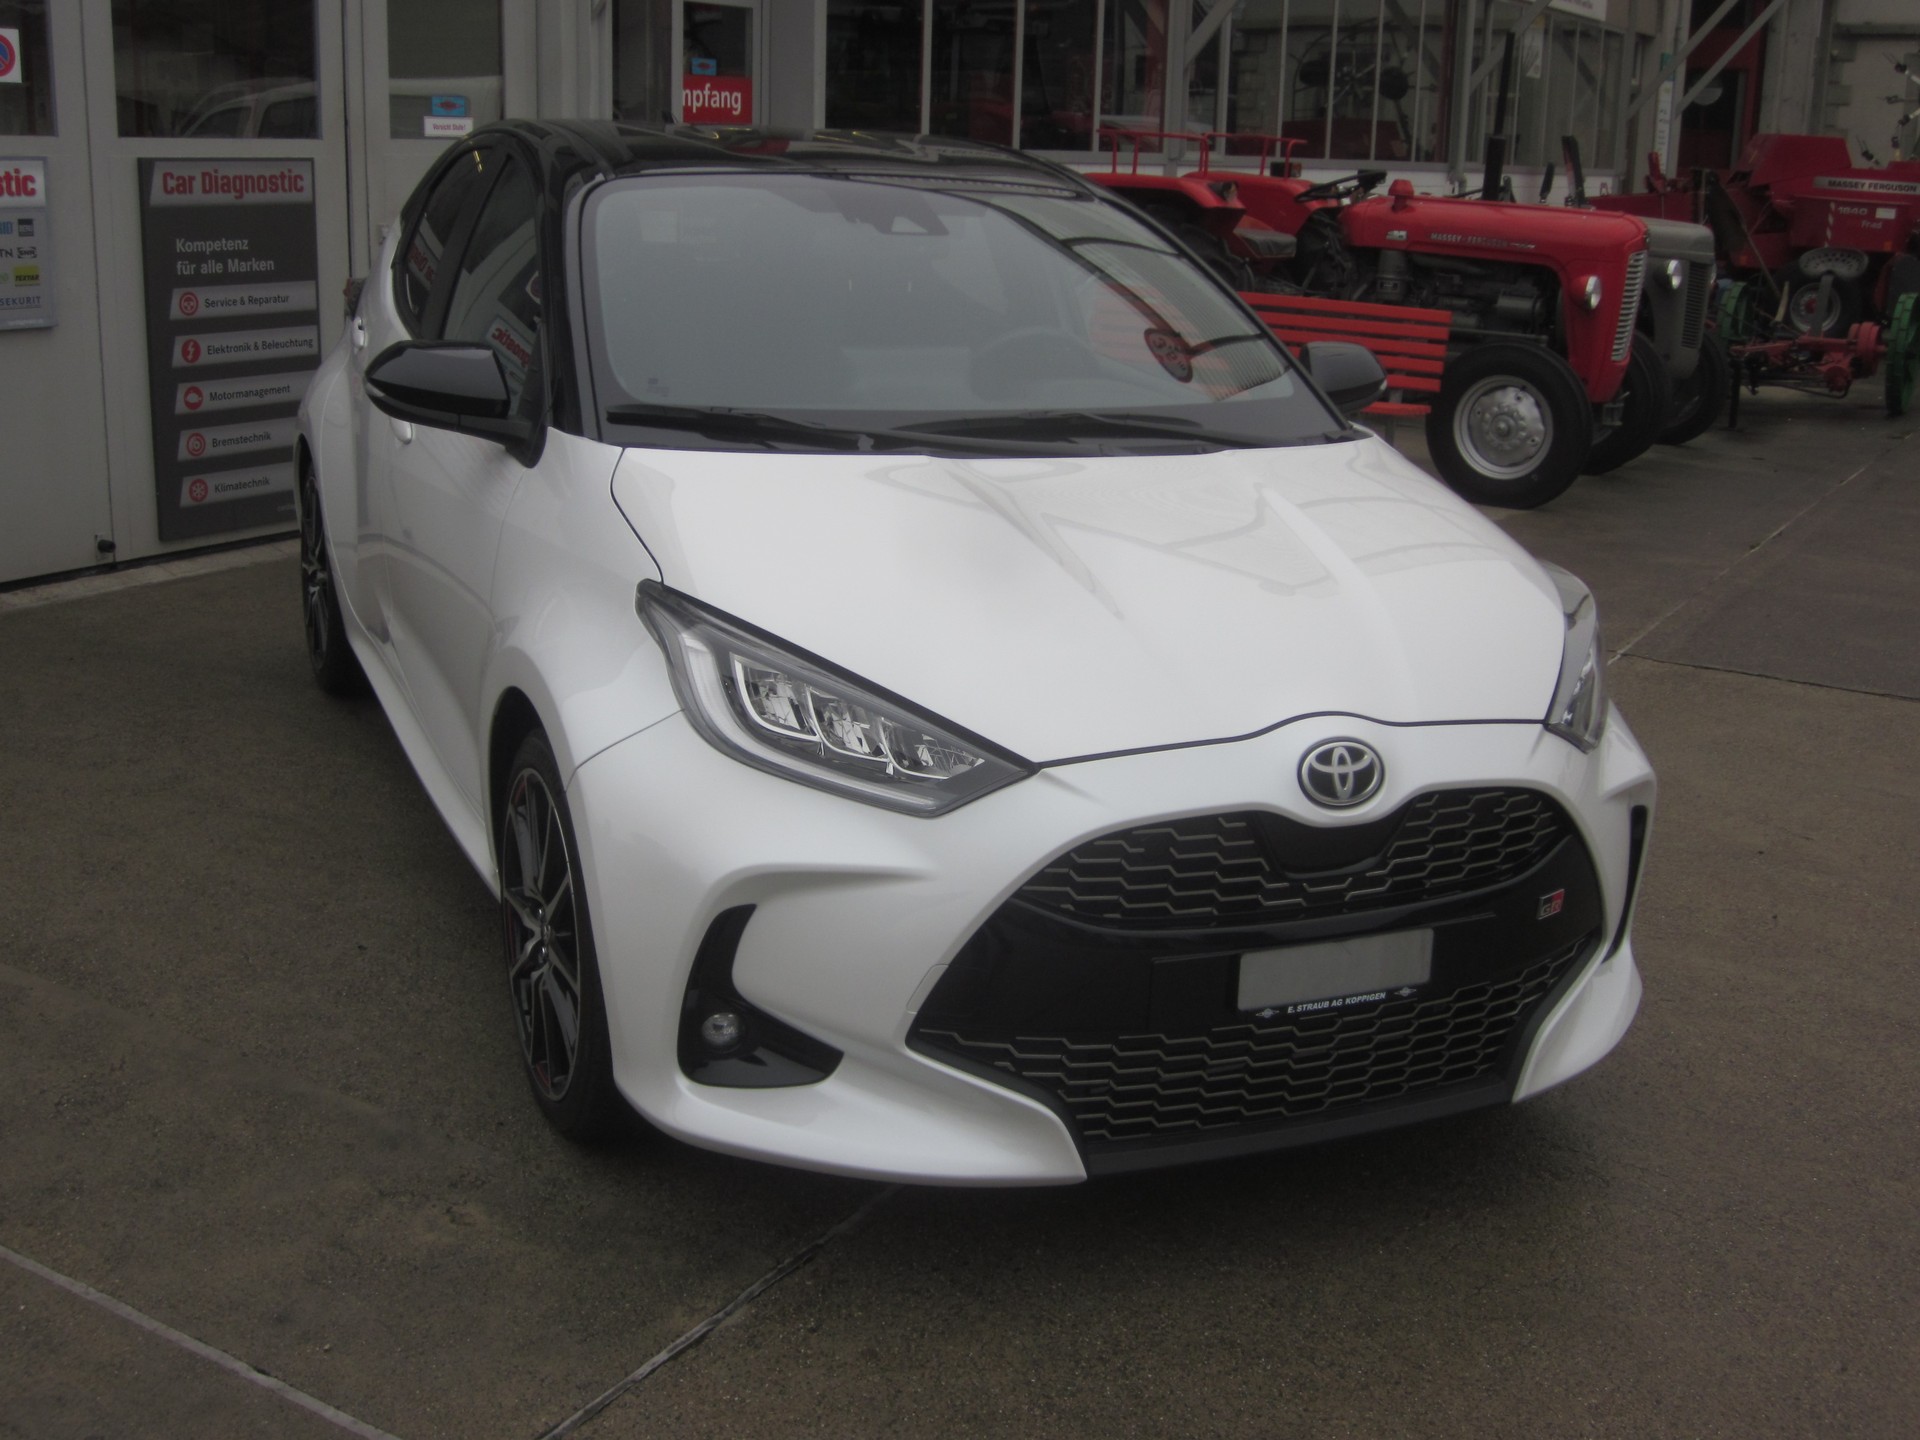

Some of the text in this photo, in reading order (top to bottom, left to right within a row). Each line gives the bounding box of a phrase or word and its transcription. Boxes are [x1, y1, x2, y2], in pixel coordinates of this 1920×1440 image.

[162, 168, 305, 200] Car Diagnostic
[1828, 180, 1918, 192] MASSEY FERGUSON
[175, 238, 249, 254] Kompetenz
[1430, 232, 1463, 243] MASSEY
[176, 257, 275, 275] für alle Marken
[204, 295, 290, 309] Service & Reparatur
[207, 338, 313, 356] Elektronik & Beleuchtung
[209, 385, 291, 402] Motormanagement
[211, 431, 272, 448] Bremstechnik
[214, 477, 271, 493] Klimatechnik
[1296, 1000, 1330, 1013] STRAUB
[1330, 999, 1343, 1008] AG
[1345, 992, 1387, 1005] KOPPIGEN
